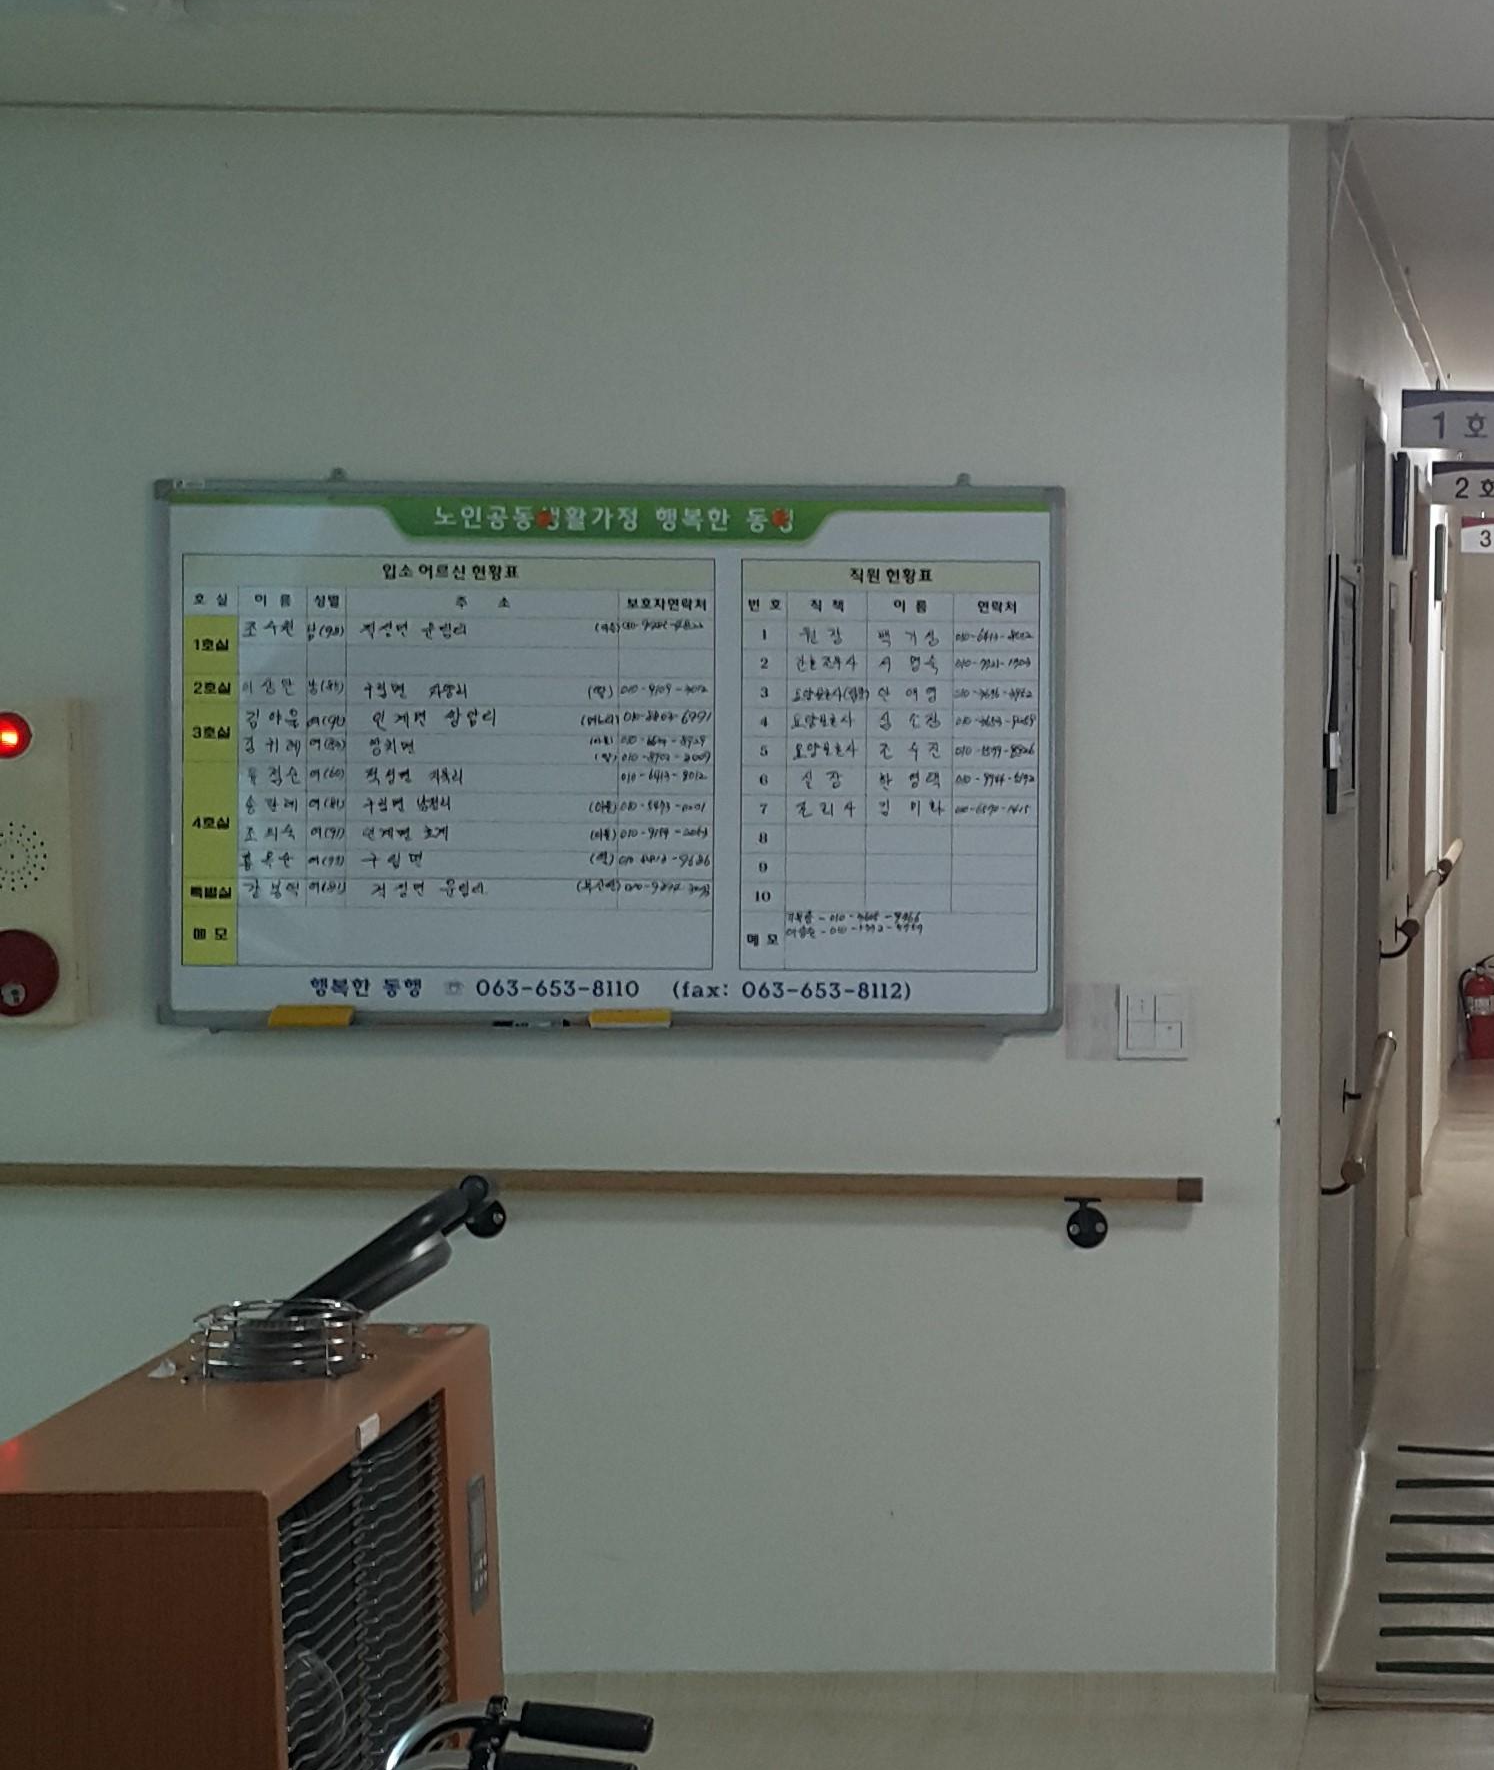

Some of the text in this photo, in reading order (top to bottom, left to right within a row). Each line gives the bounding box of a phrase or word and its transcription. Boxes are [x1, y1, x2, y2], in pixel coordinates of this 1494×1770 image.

[655, 506, 730, 533] 행복한
[382, 562, 519, 581] 입소 어르신 현황표
[850, 568, 933, 584] 직원 현황표
[314, 593, 340, 609] 성별
[627, 597, 707, 612] 보호자연락처
[977, 599, 1017, 614] 연락처
[193, 638, 230, 652] 1호실
[760, 658, 769, 669] 2
[193, 681, 232, 695] 2호실
[760, 687, 769, 698] 3
[192, 725, 231, 740] 3호실
[759, 746, 768, 757] 5
[759, 774, 768, 785] 6
[759, 803, 768, 815] 7
[191, 816, 231, 830] 4호실
[758, 832, 768, 844] 8
[758, 861, 768, 873] 9
[755, 890, 771, 902] 10
[310, 977, 912, 1001] 행복한 동행 063-653-8110 (fax: 063-653-8112)
